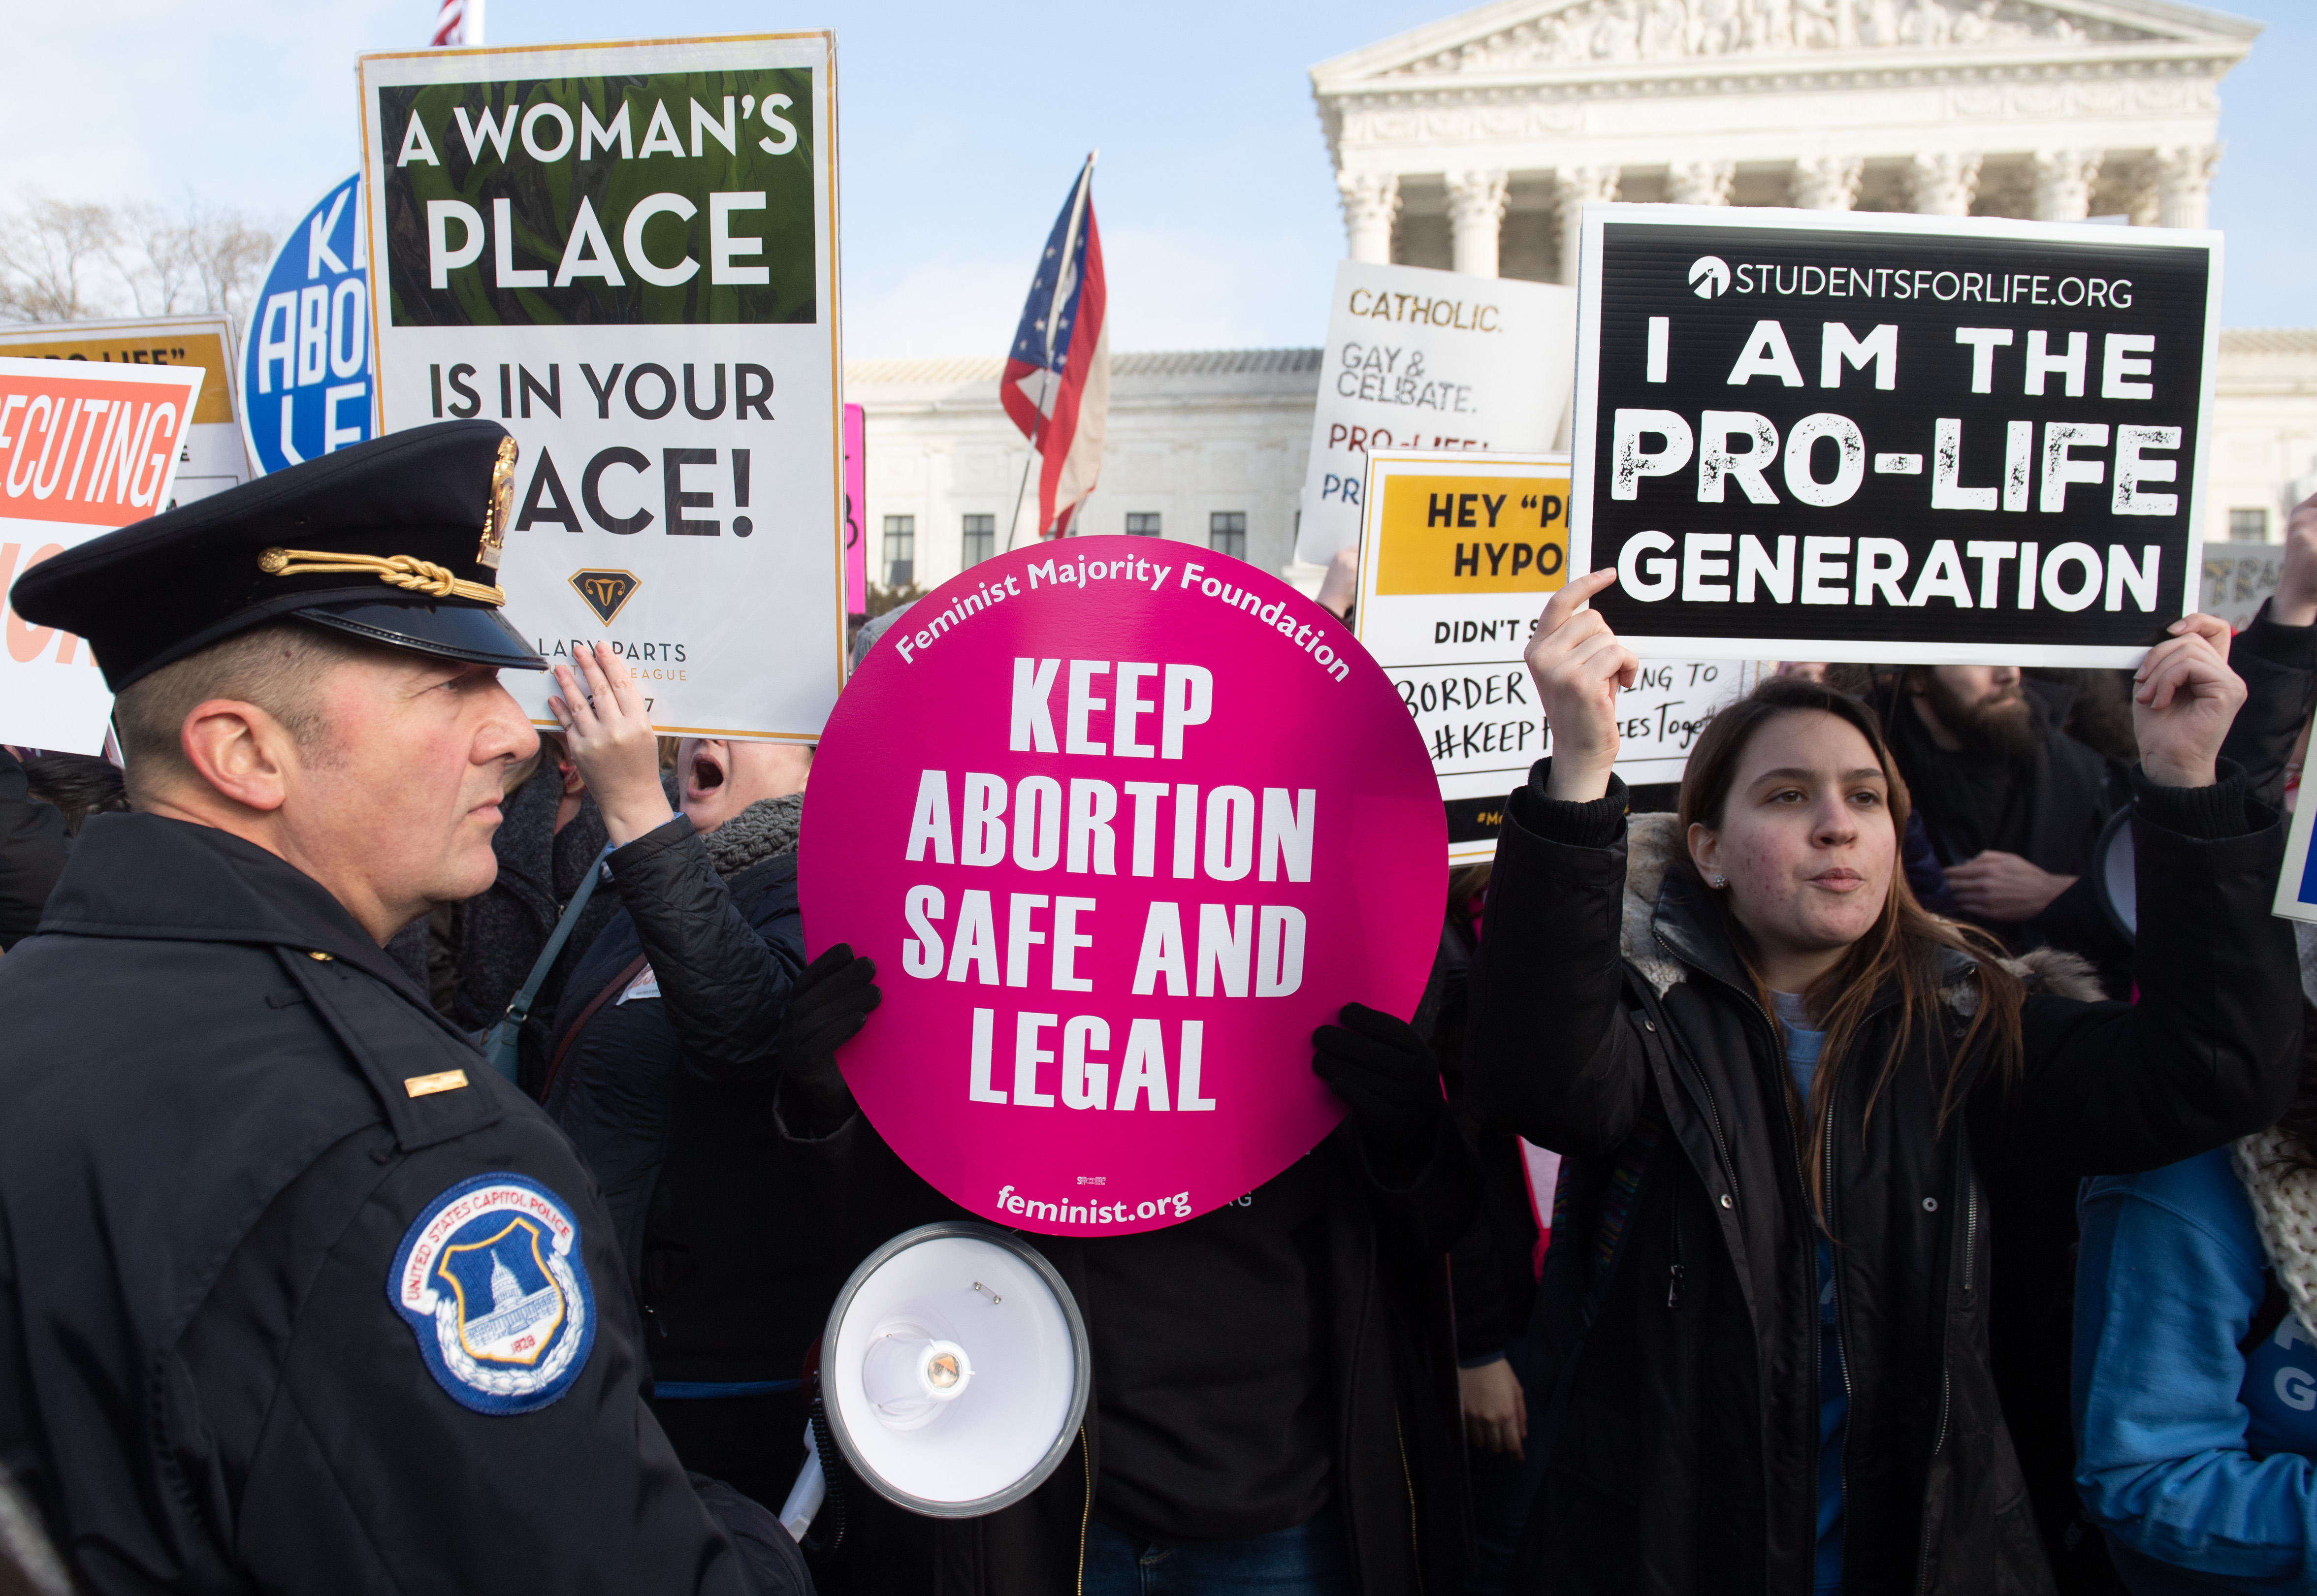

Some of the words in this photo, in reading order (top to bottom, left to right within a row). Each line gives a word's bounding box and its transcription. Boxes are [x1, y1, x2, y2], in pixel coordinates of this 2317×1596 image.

[396, 109, 440, 167] A
[426, 191, 770, 289] PLACE
[1349, 287, 1502, 333] CATHOLIC.
[1735, 263, 2133, 309] STUDENTSFORLIFE.ORG
[430, 363, 482, 418] IS
[499, 363, 562, 419] IN
[579, 362, 775, 421] YOUR
[1342, 341, 1402, 374] GAY
[1405, 350, 1425, 379] &
[1646, 316, 1670, 383] I
[1727, 319, 1899, 391] AM
[1955, 327, 2156, 400] THE
[0, 394, 176, 508] ECUTING
[1610, 408, 2182, 516] PRO-LIFE
[514, 446, 754, 538] ACE!
[1427, 493, 1507, 528] HEY
[1454, 543, 1569, 576] HYPO
[1617, 530, 2161, 612] GENERATION
[611, 640, 686, 662] PARTS
[895, 573, 1020, 665] Feminist
[1028, 553, 1172, 591] Majority
[1180, 562, 1350, 683] Foundation
[630, 668, 687, 681] EAGUE
[1009, 656, 1214, 760] KEEP
[1687, 663, 1718, 687] TO
[904, 769, 1317, 883] ABORTION
[902, 884, 1096, 993] SAFE
[1131, 901, 1307, 998] AND
[968, 1007, 1217, 1112] LEGAL
[996, 1184, 1192, 1225] feminist.org
[407, 1245, 432, 1301] UNITED
[428, 1202, 471, 1243] STATES
[473, 1191, 526, 1209] CAPITOL
[530, 1197, 570, 1238] POLICE
[510, 1335, 536, 1354] 1828
